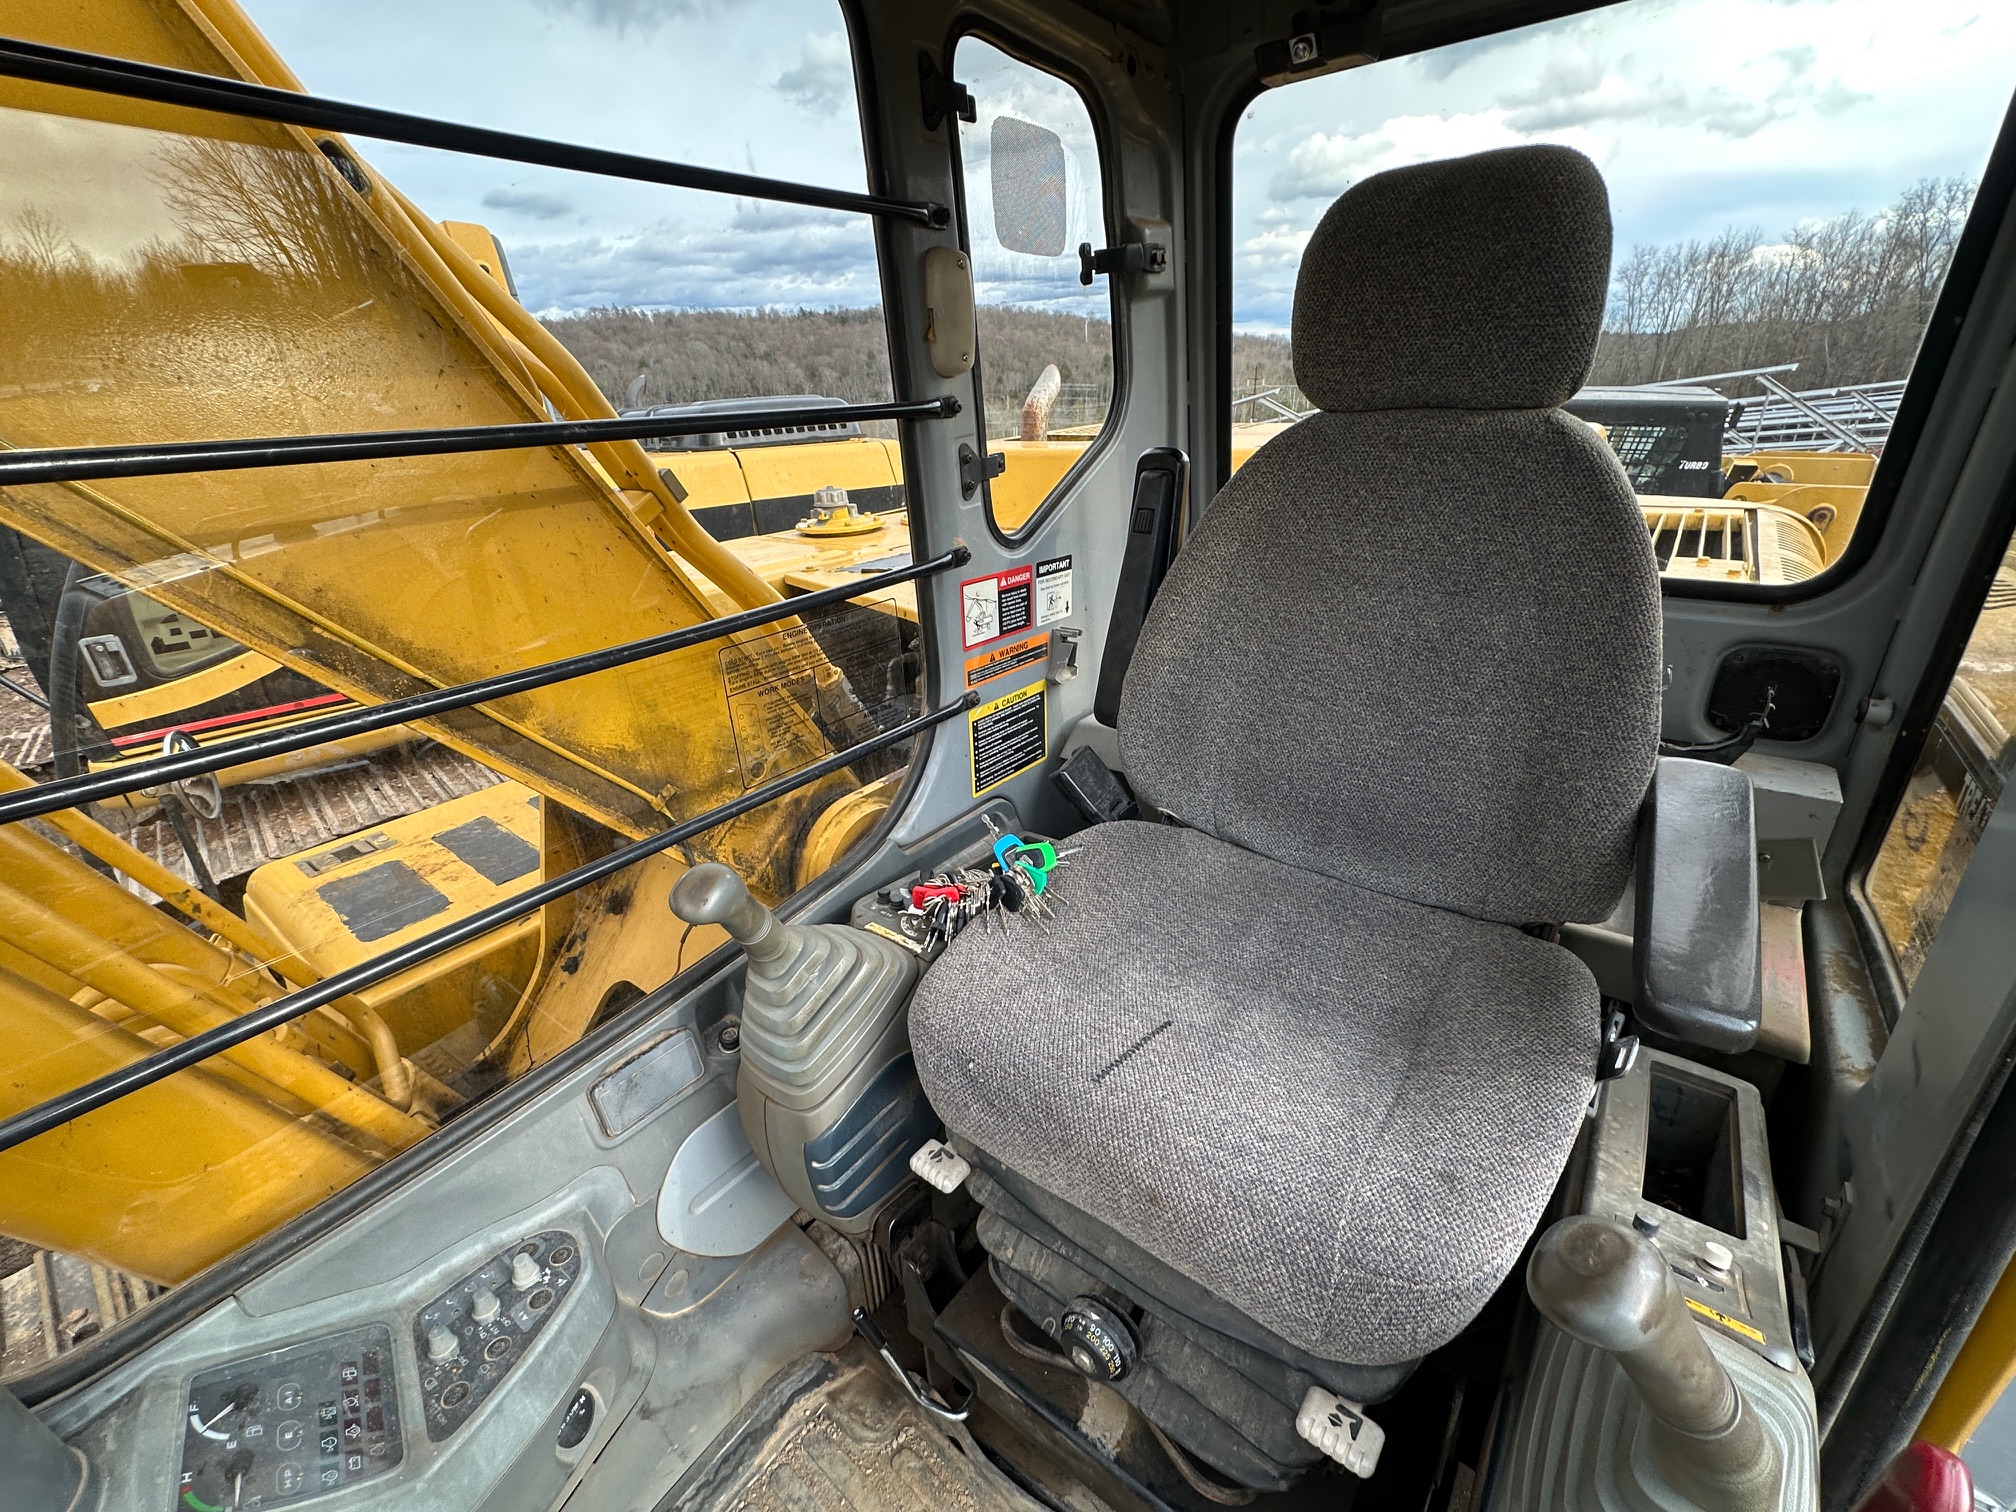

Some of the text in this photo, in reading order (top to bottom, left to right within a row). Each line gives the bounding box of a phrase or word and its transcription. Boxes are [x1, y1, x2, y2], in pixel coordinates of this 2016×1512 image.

[1678, 459, 1709, 470] TURBO
[1038, 559, 1070, 574] IMPORTANT
[1007, 572, 1031, 585] DANGER
[782, 616, 846, 640] ENGINE OPERATION
[998, 641, 1029, 658] WARNING
[757, 676, 805, 697] WORK MODES
[1001, 690, 1028, 707] CAUTION
[1086, 1331, 1100, 1346] 200
[1090, 1323, 1101, 1336] 90
[1102, 1335, 1114, 1352] 100
[189, 1403, 200, 1412] F
[284, 1431, 293, 1439] E
[226, 1439, 237, 1450] E
[181, 1471, 193, 1483] H
